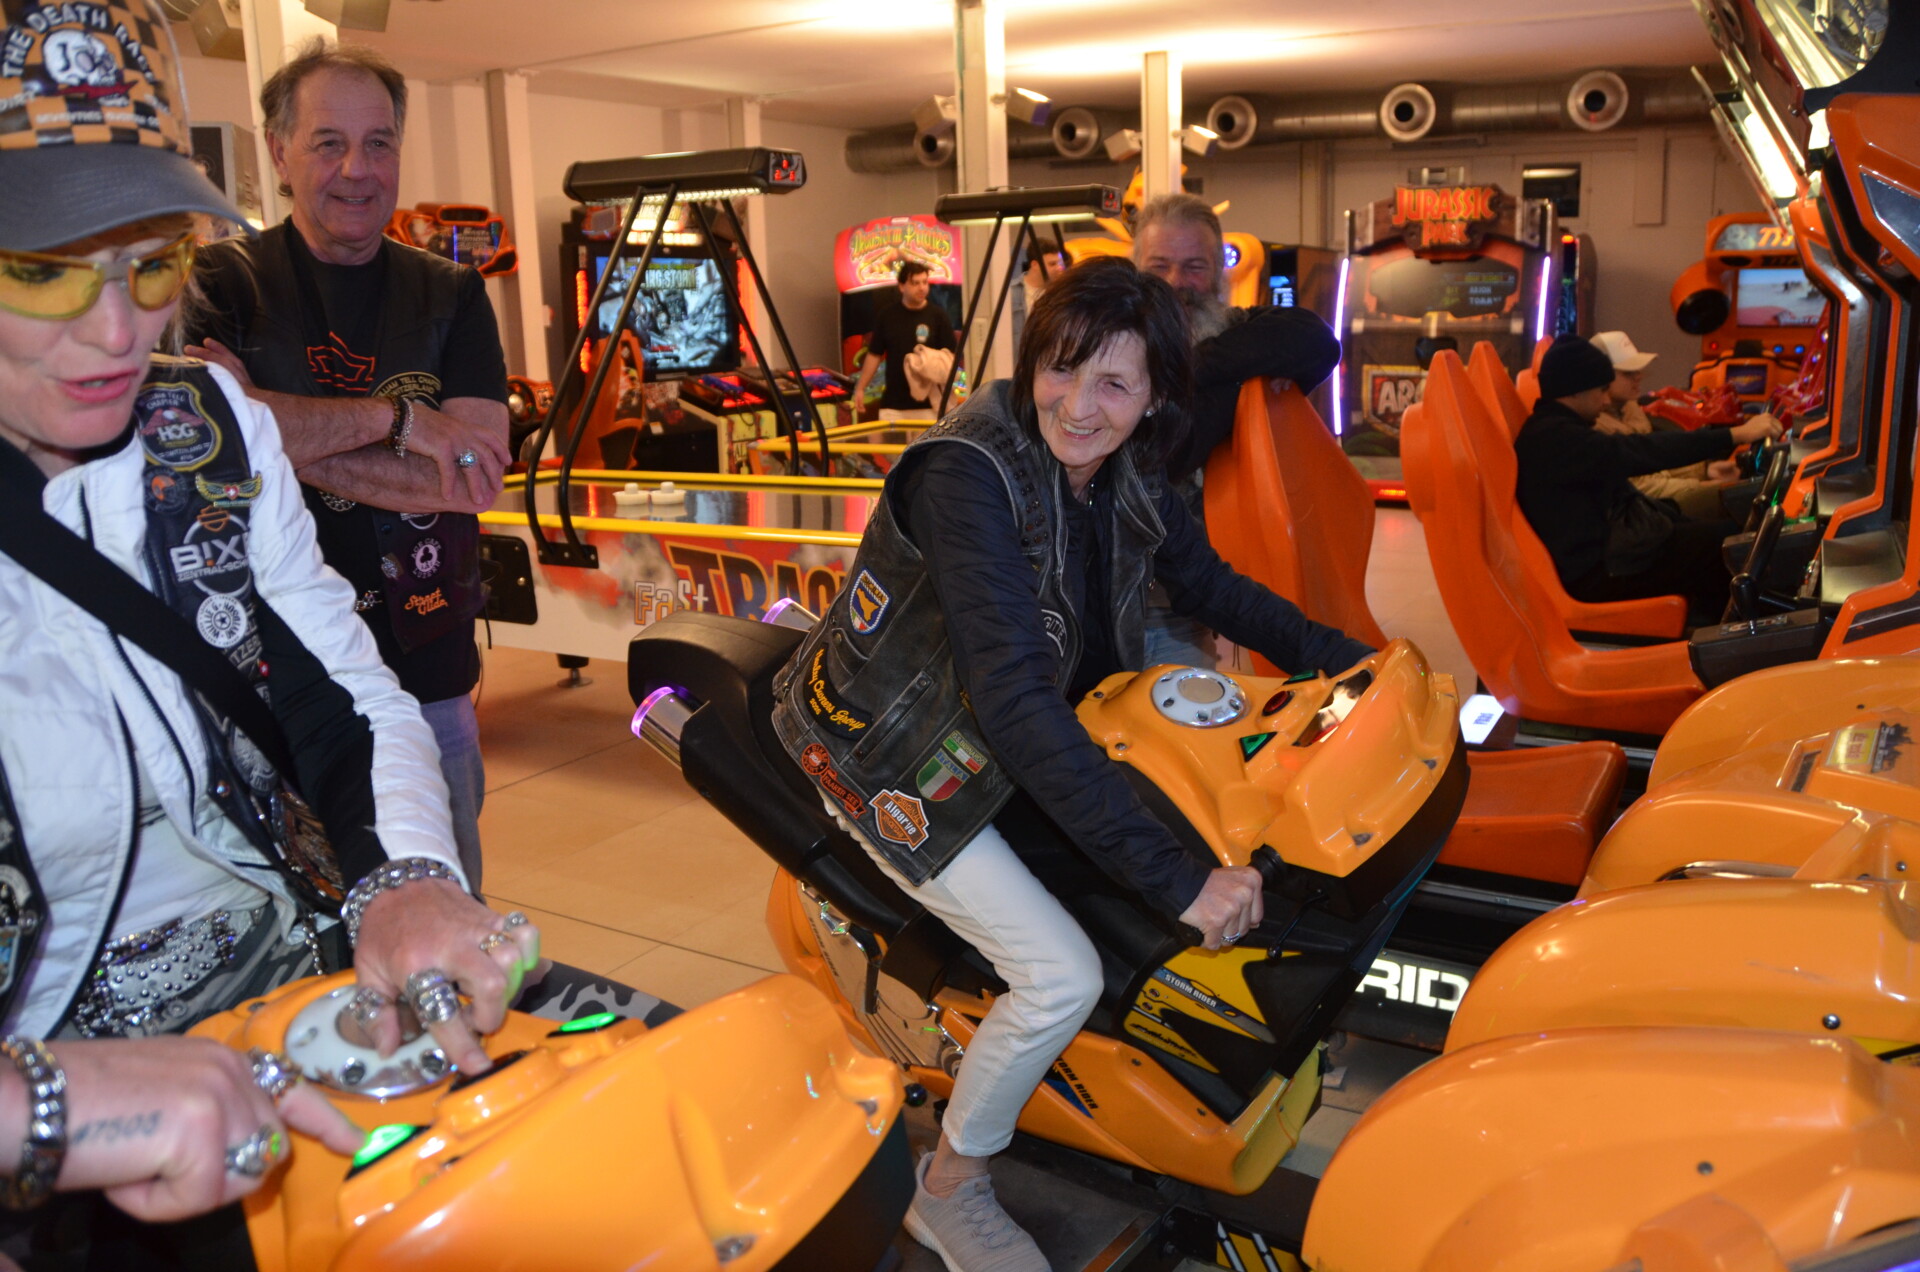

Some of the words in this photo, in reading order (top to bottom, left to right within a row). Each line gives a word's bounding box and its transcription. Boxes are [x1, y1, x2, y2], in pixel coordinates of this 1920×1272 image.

[2, 28, 34, 78] THE
[26, 3, 108, 34] DEATH
[1392, 186, 1496, 225] JURASSIC
[1422, 220, 1468, 246] PARK
[157, 421, 196, 443] HOG
[404, 587, 443, 610] Street
[861, 574, 888, 606] SICILIA
[417, 598, 449, 616] Glide
[808, 648, 825, 685] Harley
[813, 680, 836, 714] Owners
[829, 709, 866, 732] Group
[936, 751, 967, 781] ITALIA
[822, 775, 847, 797] FAAKER
[845, 792, 860, 809] SEE
[883, 800, 917, 835] Algarve
[1165, 973, 1194, 994] STORM
[1192, 990, 1217, 1008] RIDER
[1074, 1083, 1098, 1109] RIDER
